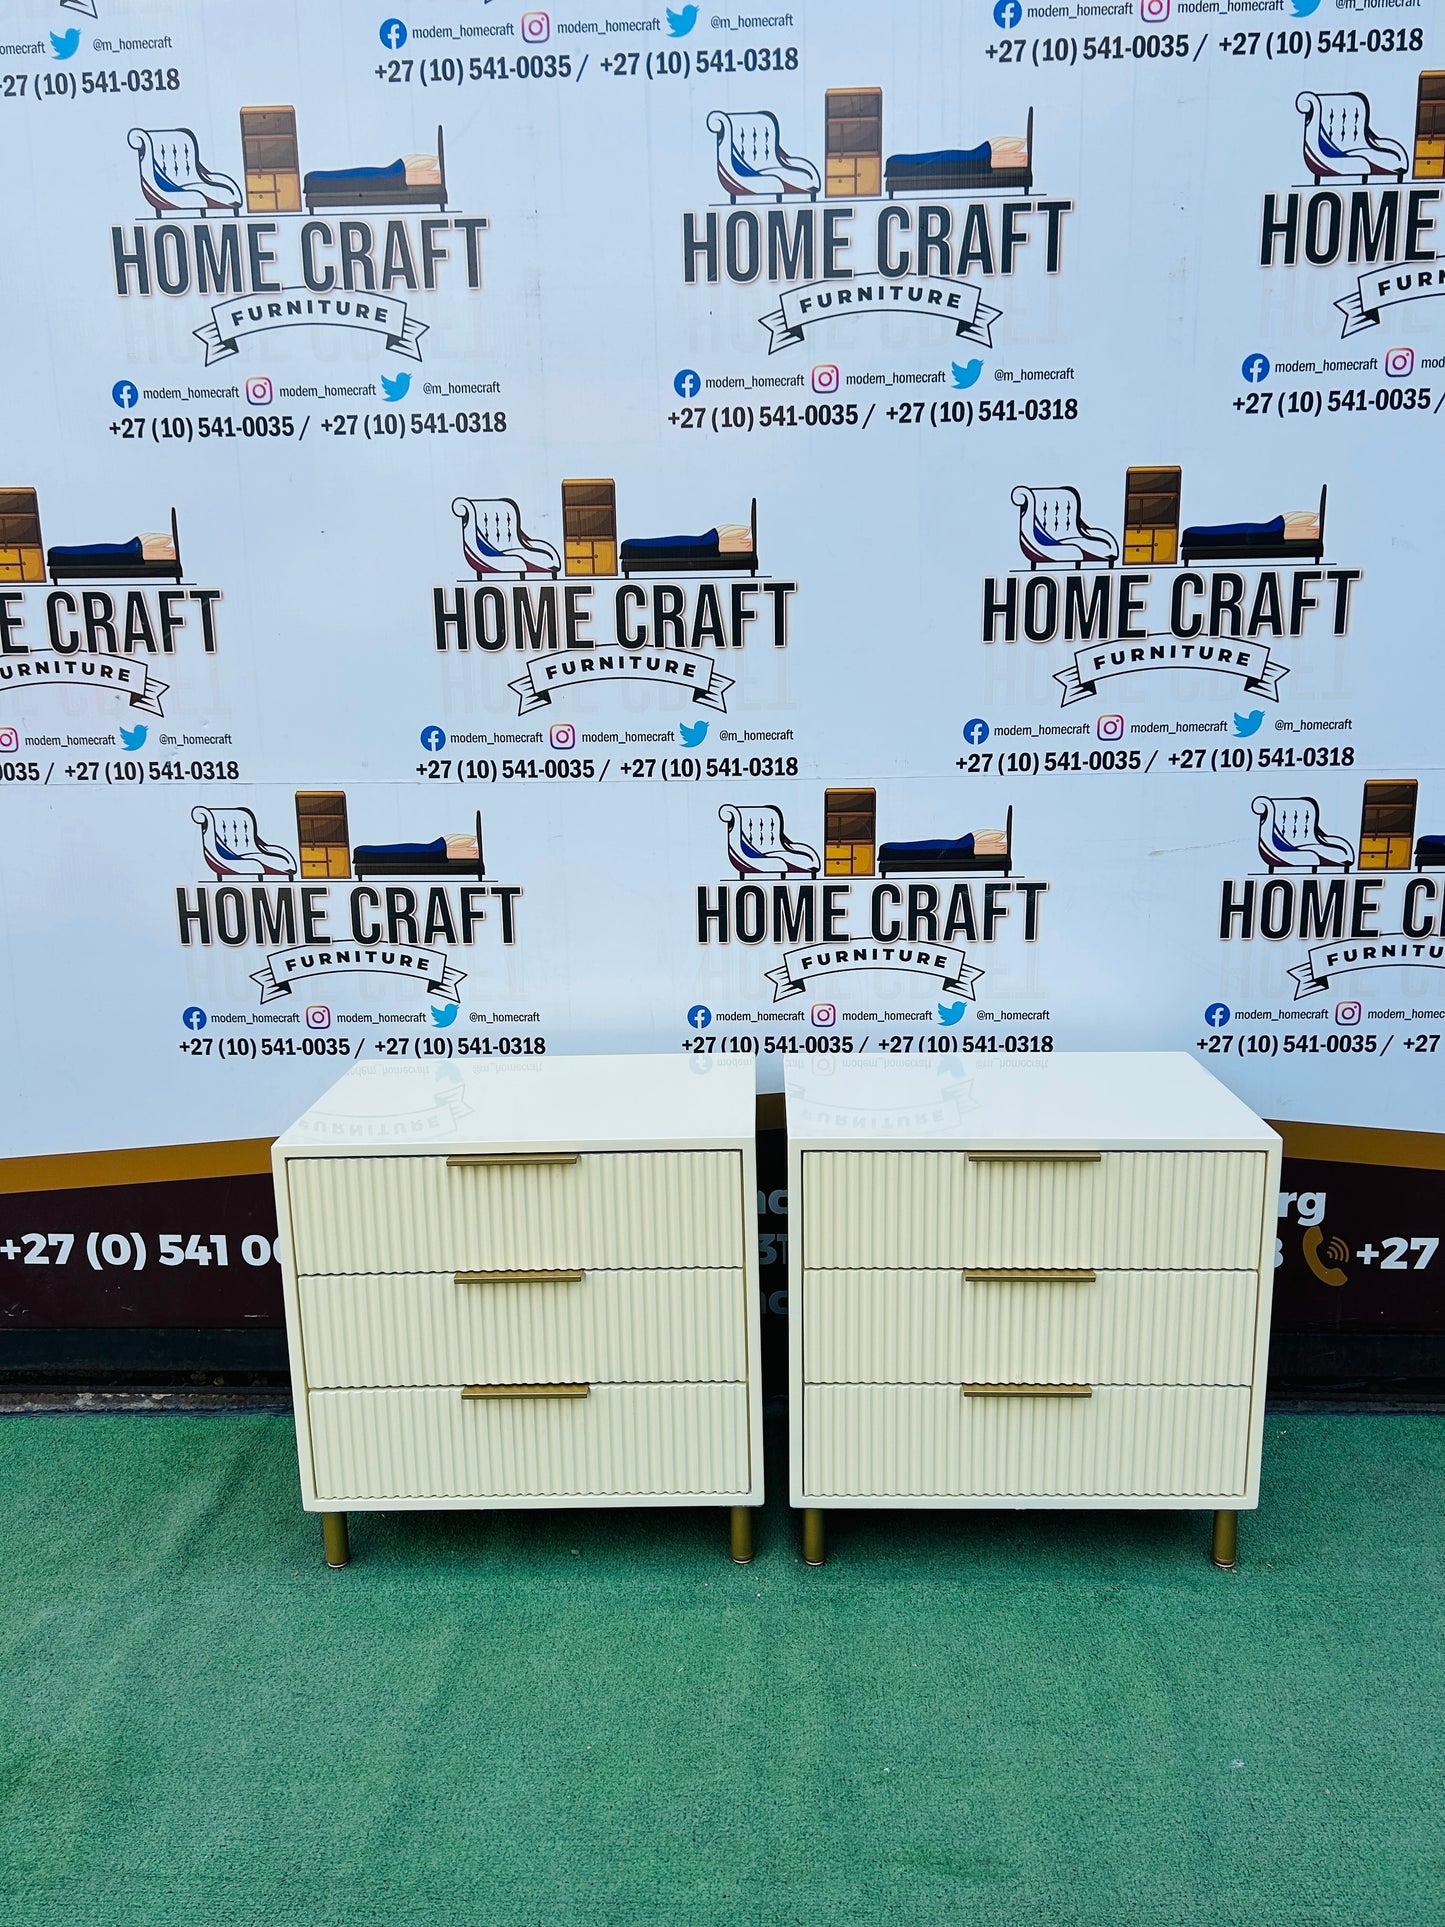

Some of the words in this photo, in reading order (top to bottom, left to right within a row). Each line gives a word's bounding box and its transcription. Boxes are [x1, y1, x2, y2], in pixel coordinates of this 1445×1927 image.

[711, 13, 793, 30] @m_homecraft
[93, 36, 172, 53] @m_homecraft
[986, 39, 1026, 63] +27
[1032, 38, 1077, 67] (10)
[1083, 34, 1189, 60] 541-0035
[1219, 32, 1261, 55] +27
[1266, 31, 1311, 60] (10)
[1317, 28, 1423, 53] 541-0318
[375, 60, 413, 82] +27
[420, 58, 463, 87] (10)
[469, 55, 571, 80] 541-0035
[600, 53, 640, 75] +27
[646, 51, 690, 80] (10)
[696, 47, 798, 73] 541-0318
[34, 71, 77, 100] (10)
[82, 68, 181, 94] 541-0318
[684, 209, 855, 283] HOME
[876, 201, 1072, 277] CRAFT
[1261, 190, 1441, 266] HOME
[111, 223, 281, 297] HOME
[301, 217, 488, 292] CRAFT
[231, 300, 388, 326] FURNITURE
[800, 286, 961, 314] FURNITURE
[423, 381, 501, 396] @m_homecraft
[994, 368, 1074, 383] @m_homecraft
[668, 408, 706, 428] +27
[712, 406, 754, 433] (10)
[759, 404, 858, 427] 541-0035
[886, 402, 925, 423] +27
[931, 401, 973, 427] (10)
[978, 398, 1078, 422] 541-0318
[1233, 392, 1273, 414] +27
[1278, 391, 1322, 418] (10)
[1327, 388, 1431, 412] 541-0035
[109, 418, 145, 438] +27
[152, 417, 193, 443] (10)
[198, 416, 294, 438] 541-0035
[321, 415, 358, 435] +27
[364, 414, 405, 440] (10)
[411, 412, 506, 434] 541-0318
[433, 584, 594, 652] HOME
[615, 580, 797, 649] CRAFT
[982, 576, 1150, 644] HOME
[1170, 570, 1362, 639] CRAFT
[47, 588, 222, 656] CRAFT
[545, 656, 696, 680] FURNITURE
[1093, 645, 1250, 670] FURNITURE
[720, 729, 794, 743] @m_homecraft
[1275, 719, 1352, 732] @m_homecraft
[159, 734, 232, 746] @m_homecraft
[0, 761, 40, 782] 0035
[65, 762, 99, 781] +27
[105, 762, 144, 784] (10)
[149, 761, 239, 780] 541-0318
[415, 760, 452, 779] +27
[458, 760, 497, 784] (10)
[501, 758, 595, 779] 541-0035
[620, 759, 656, 777] +27
[662, 758, 701, 782] (10)
[706, 756, 800, 778] 541-0318
[956, 753, 993, 772] +27
[998, 752, 1039, 776] (10)
[1044, 750, 1141, 774] 541-0035
[1168, 749, 1208, 773] +27
[1211, 749, 1253, 772] (10)
[1258, 747, 1354, 767] 541-0318
[177, 886, 333, 946] HOME
[350, 886, 521, 945] CRAFT
[698, 885, 850, 944] HOME
[872, 881, 1048, 942] CRAFT
[1219, 878, 1387, 940] HOME
[285, 951, 429, 972] FURNITURE
[801, 948, 947, 970] FURNITURE
[469, 1012, 540, 1024] @m_homecraft
[977, 1010, 1050, 1022] @m_homecraft
[179, 1038, 213, 1055] +27
[219, 1038, 256, 1059] (10)
[261, 1038, 350, 1055] 541-0035
[375, 1038, 409, 1055] +27
[415, 1038, 453, 1059] (10)
[458, 1037, 546, 1055] 541-0318
[682, 1036, 716, 1053] +27
[721, 1036, 760, 1056] (10)
[763, 1035, 854, 1055] 541-0035
[878, 1036, 914, 1053] +27
[918, 1036, 957, 1053] (10)
[962, 1035, 1053, 1053] 541-0318
[1197, 1035, 1233, 1053] +27
[1238, 1035, 1278, 1057] (10)
[1283, 1034, 1378, 1054] 541-0035
[1403, 1034, 1440, 1052] +27
[0, 1233, 75, 1265] +27
[86, 1232, 147, 1271] (0)
[158, 1234, 228, 1266] 541
[1356, 1237, 1440, 1269] +27
